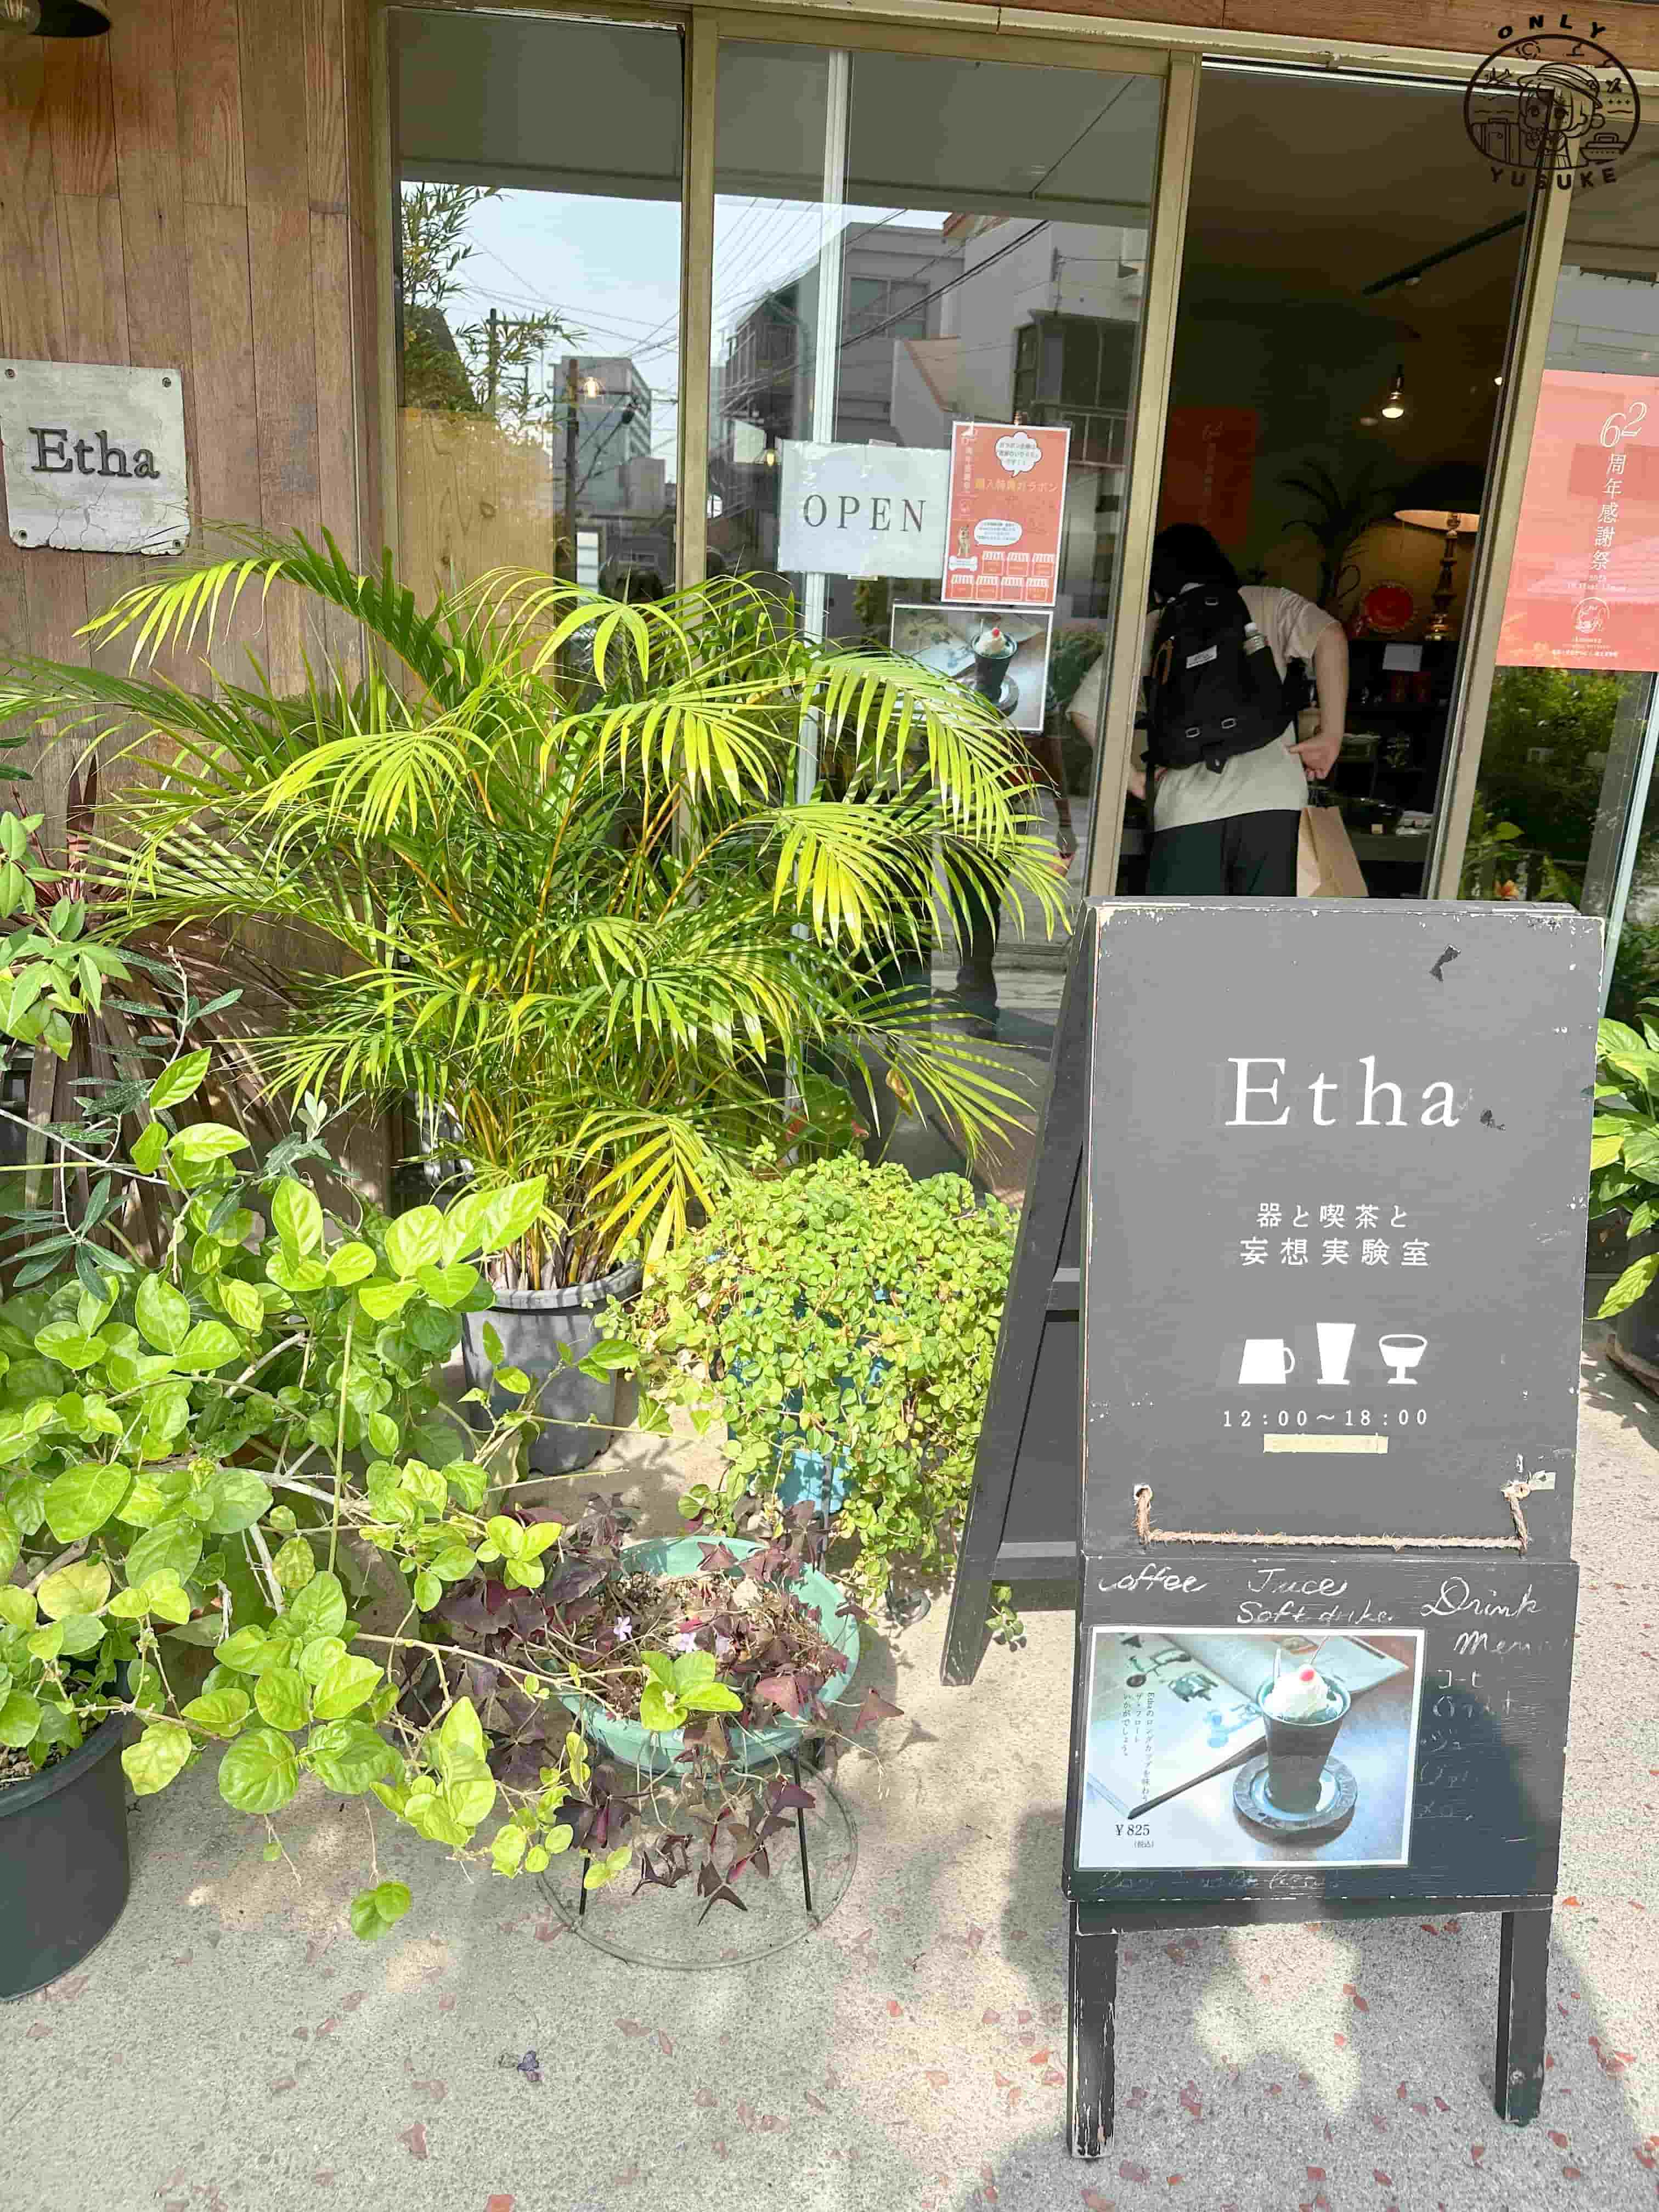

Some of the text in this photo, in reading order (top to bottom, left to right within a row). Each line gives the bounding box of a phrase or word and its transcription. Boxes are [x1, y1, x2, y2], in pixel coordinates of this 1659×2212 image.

[29, 427, 160, 479] Etha
[803, 494, 926, 532] OPEN
[1224, 1055, 1460, 1127] Etha
[1256, 1202, 1407, 1229] 器と喫茶と
[1240, 1236, 1431, 1266] 妄想実験室
[1420, 1576, 1543, 1617] Drink
